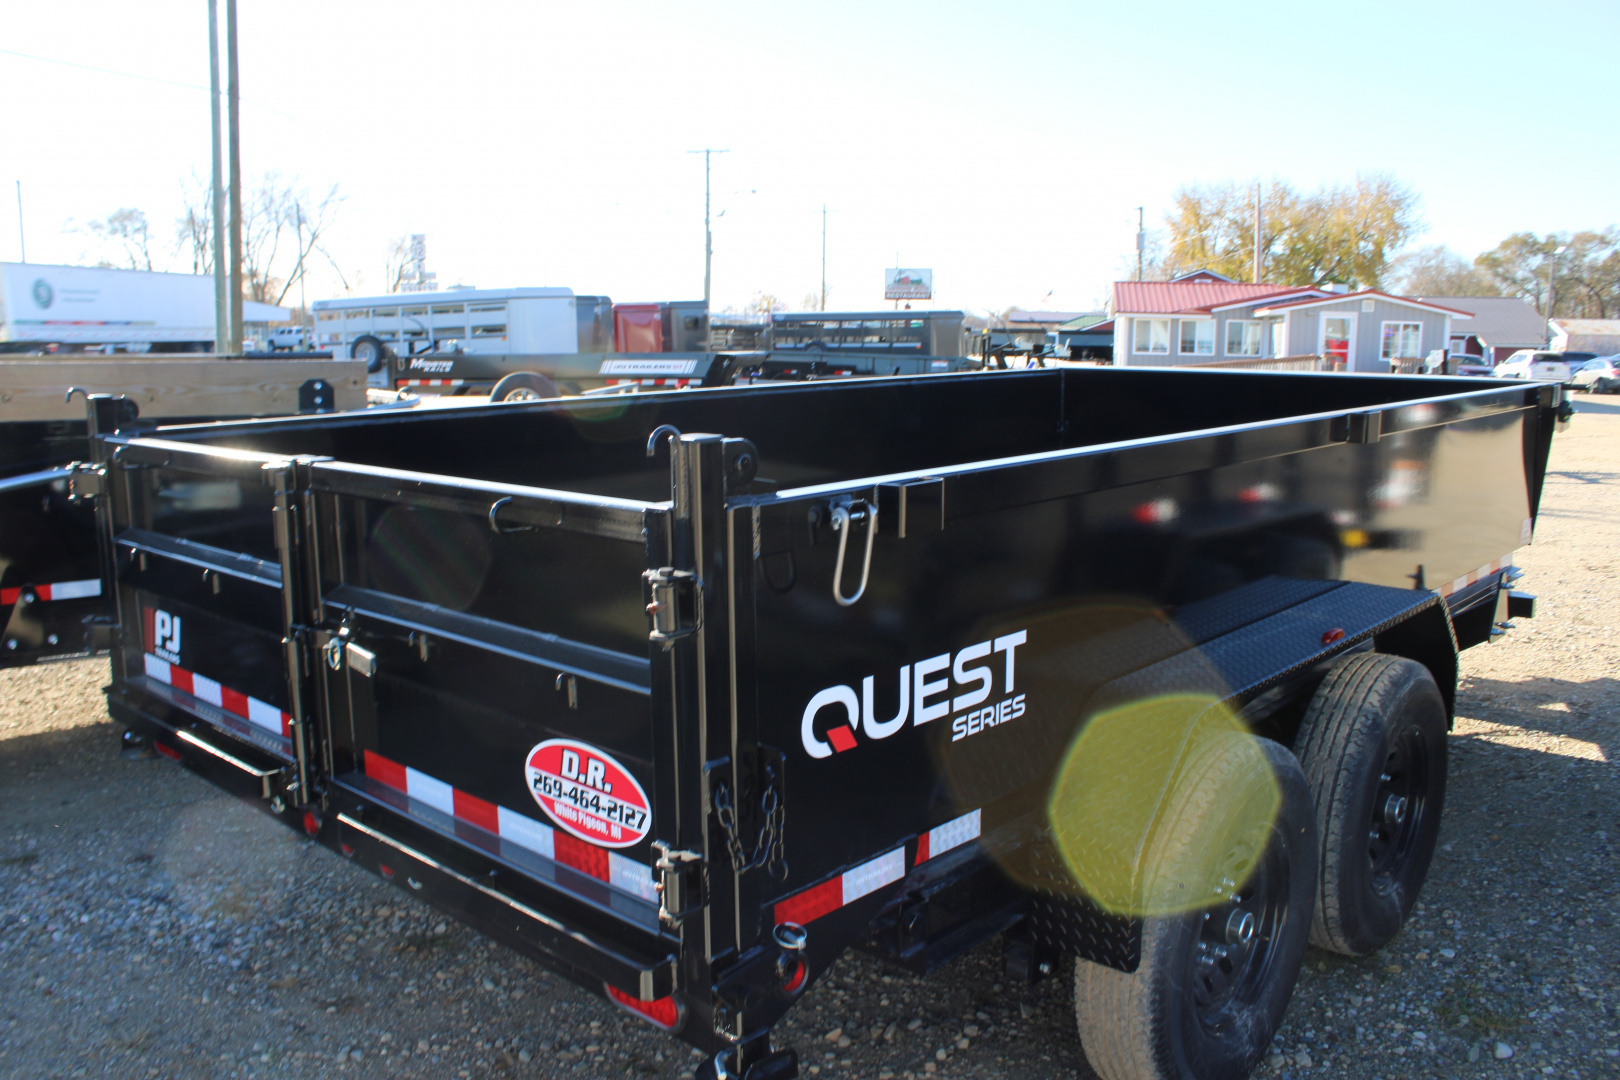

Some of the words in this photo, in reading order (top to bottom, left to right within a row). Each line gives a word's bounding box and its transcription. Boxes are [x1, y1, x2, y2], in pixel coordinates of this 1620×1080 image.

[155, 609, 181, 654] PJ
[801, 629, 1027, 759] QUEST
[952, 694, 1026, 742] SERIES
[560, 748, 612, 794] D.R.
[533, 771, 646, 830] 269-464-2127
[554, 801, 578, 822] White
[579, 811, 608, 835] Pigeon,
[611, 825, 621, 840] MI
